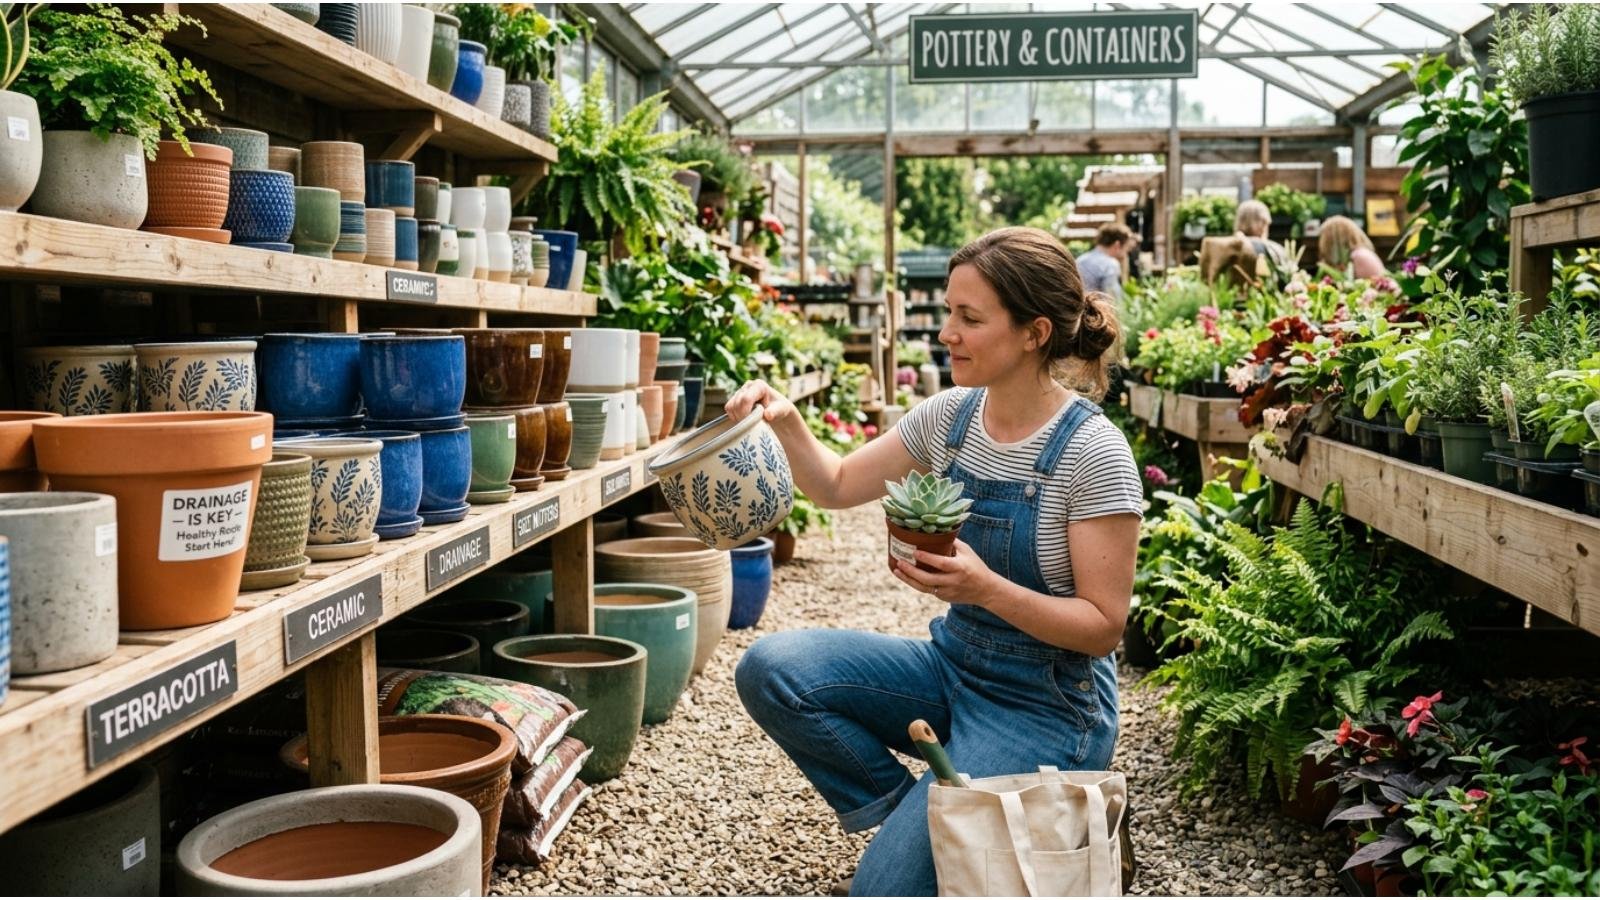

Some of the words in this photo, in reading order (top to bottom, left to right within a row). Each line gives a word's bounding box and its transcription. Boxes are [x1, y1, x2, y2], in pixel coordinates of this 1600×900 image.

[922, 29, 1011, 68] POTTERY
[1018, 29, 1038, 66] &
[1045, 25, 1186, 66] CONTAINERS
[173, 489, 248, 510] DRAINAGE
[188, 513, 202, 526] IS
[207, 508, 233, 525] KEY
[308, 592, 365, 640] CERAMIC
[99, 657, 230, 745] TERRACOTTA
